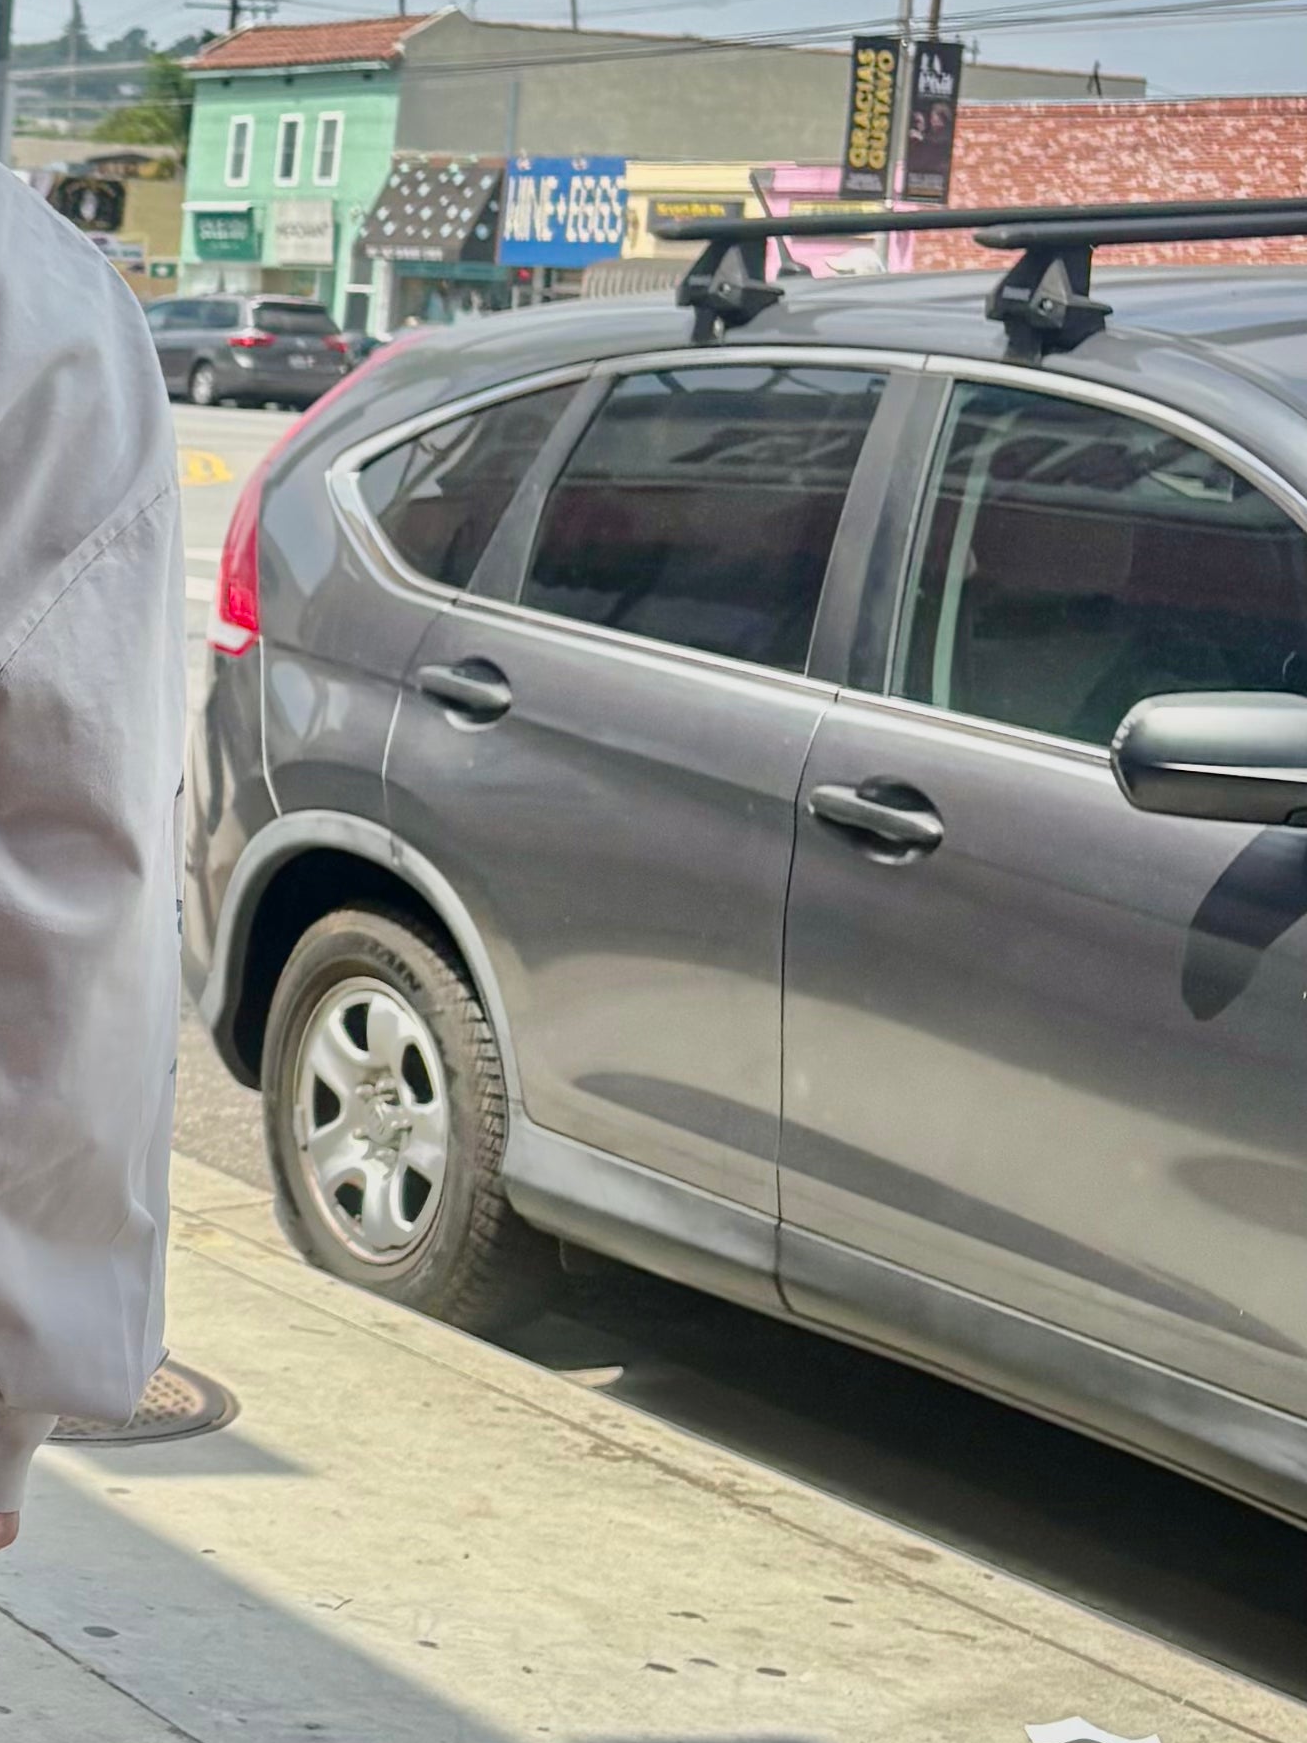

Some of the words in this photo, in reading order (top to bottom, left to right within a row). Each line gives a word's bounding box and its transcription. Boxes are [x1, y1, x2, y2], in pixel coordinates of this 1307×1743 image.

[849, 48, 875, 168] GRACIAS
[868, 50, 894, 170] GUSTAVO
[918, 73, 953, 96] Phil
